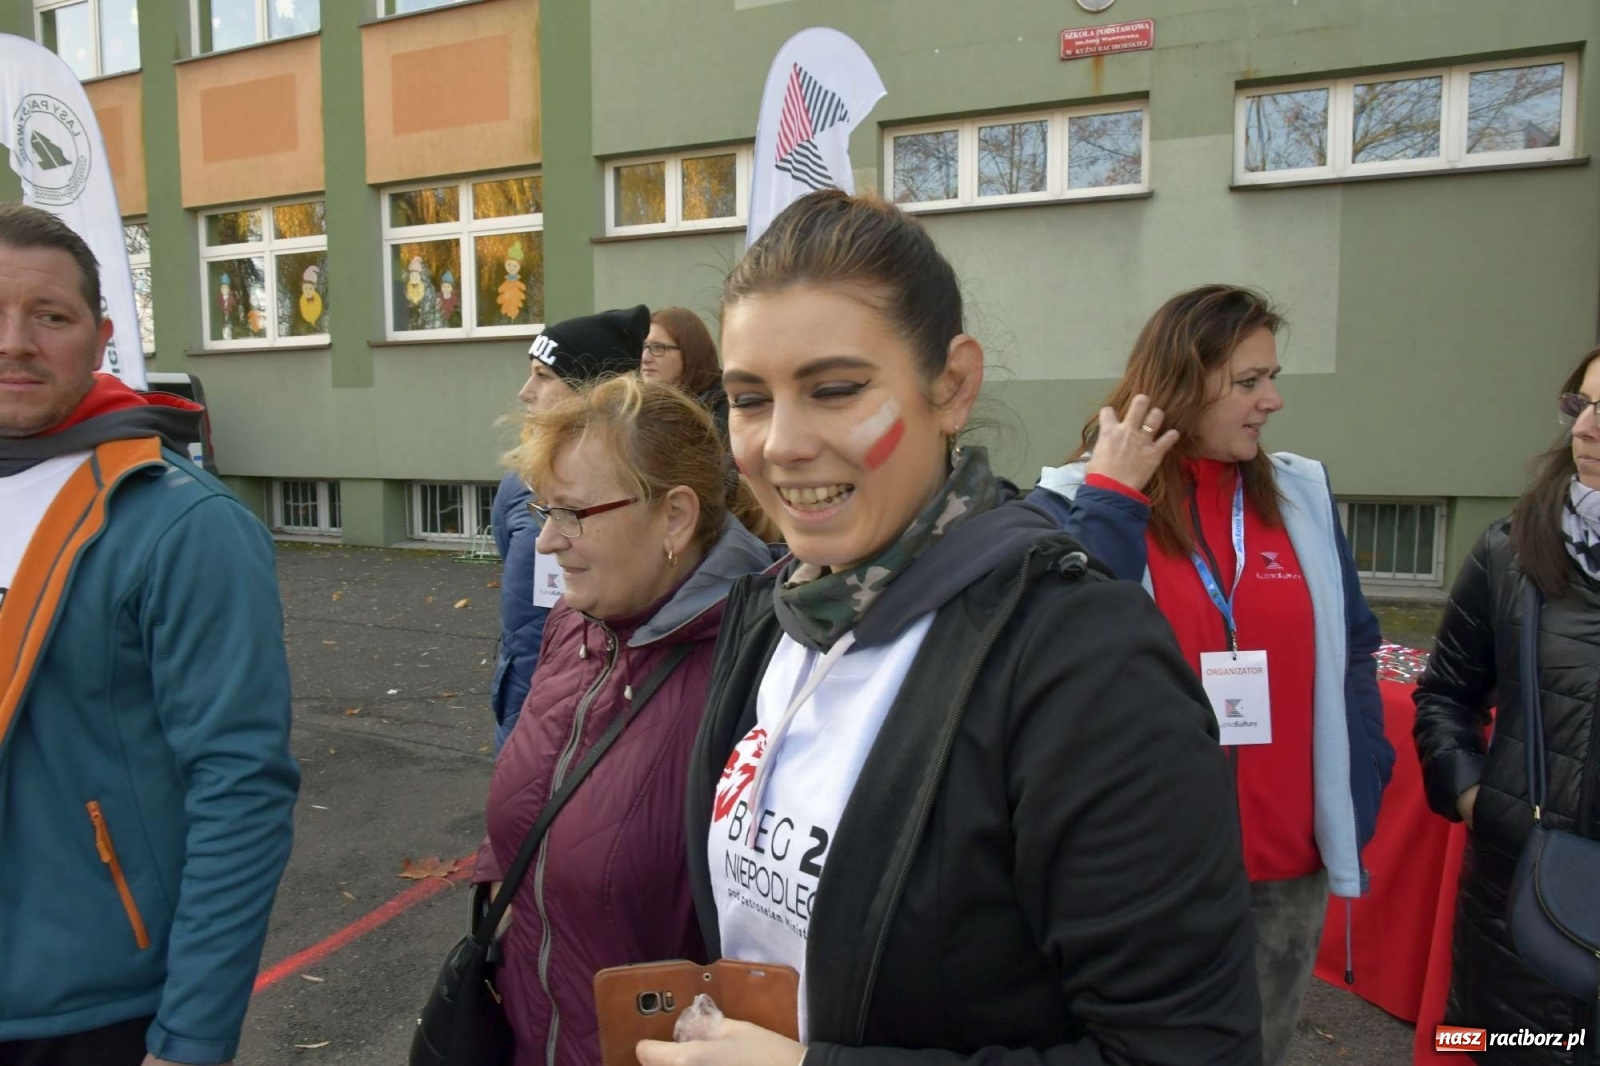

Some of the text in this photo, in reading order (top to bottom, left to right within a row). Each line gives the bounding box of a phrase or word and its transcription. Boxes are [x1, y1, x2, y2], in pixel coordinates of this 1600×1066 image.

[1096, 23, 1150, 35] PODSTAWOWA
[1206, 667, 1263, 676] ORGANIZATOR
[741, 896, 784, 923] patronatem
